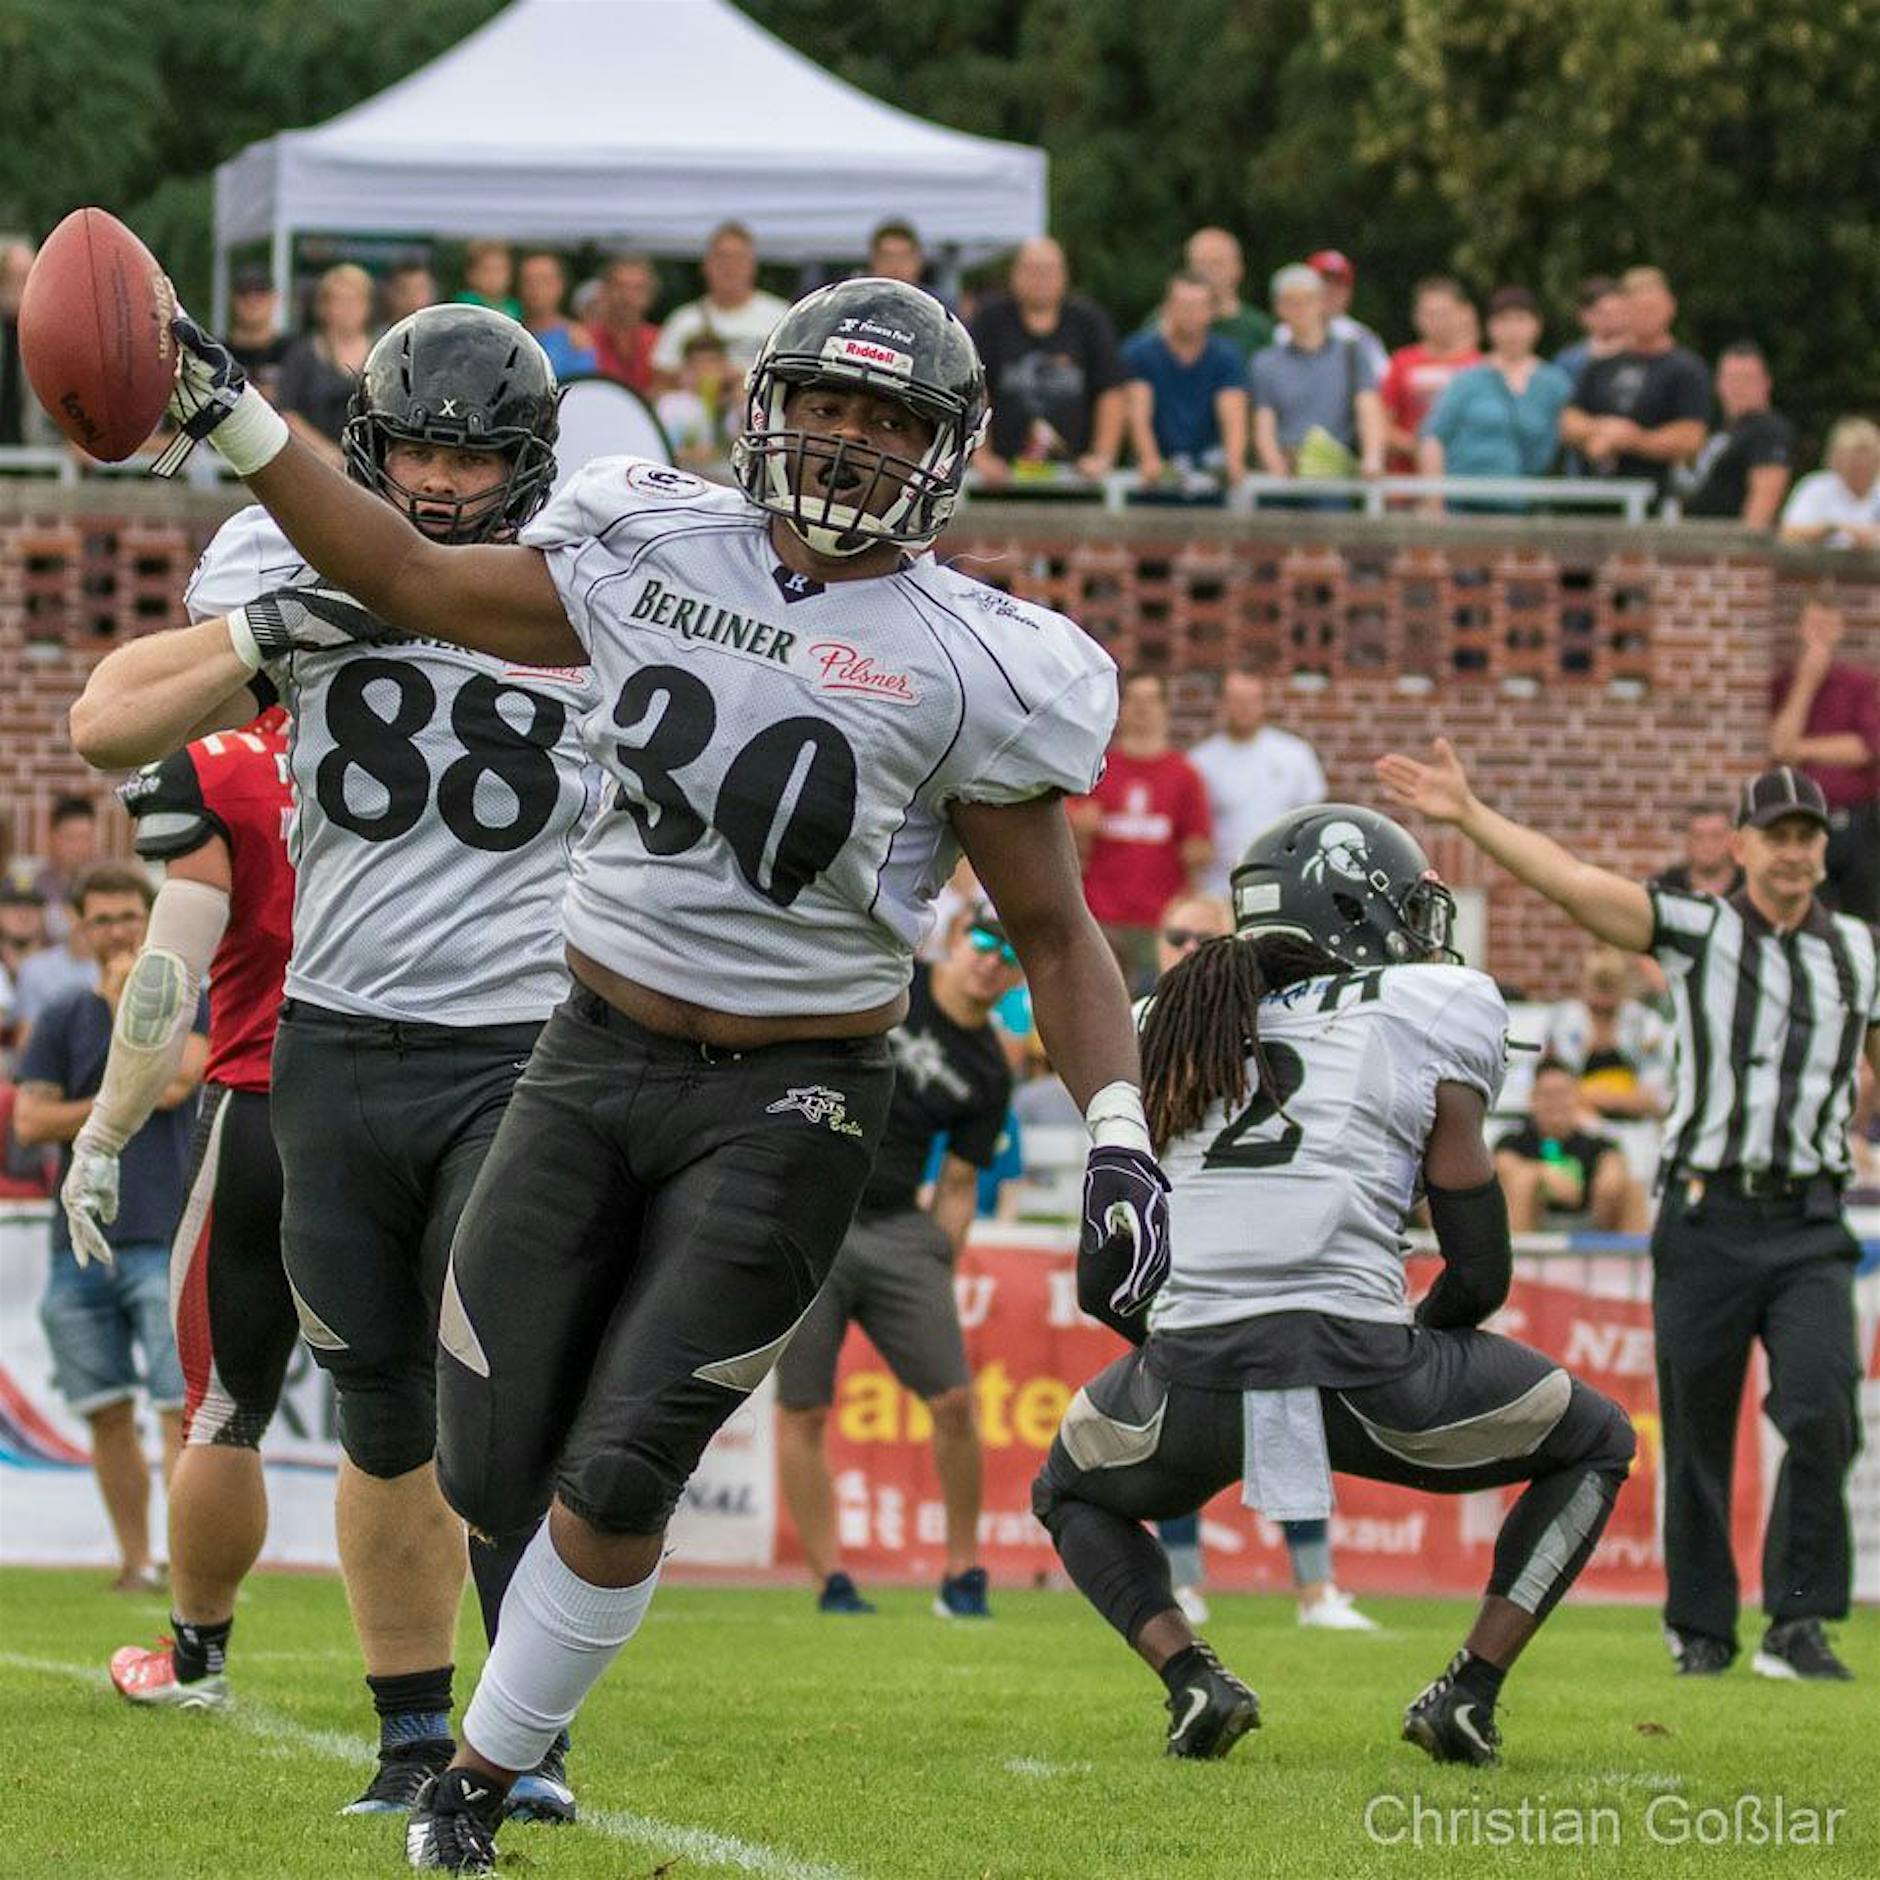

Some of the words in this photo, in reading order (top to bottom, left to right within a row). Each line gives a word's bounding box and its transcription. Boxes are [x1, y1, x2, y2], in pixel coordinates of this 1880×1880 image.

[846, 342, 895, 364] Riddell
[630, 579, 797, 666] BERLINER
[808, 643, 913, 698] Pilsner
[317, 657, 566, 852] 88
[613, 664, 857, 907] 30
